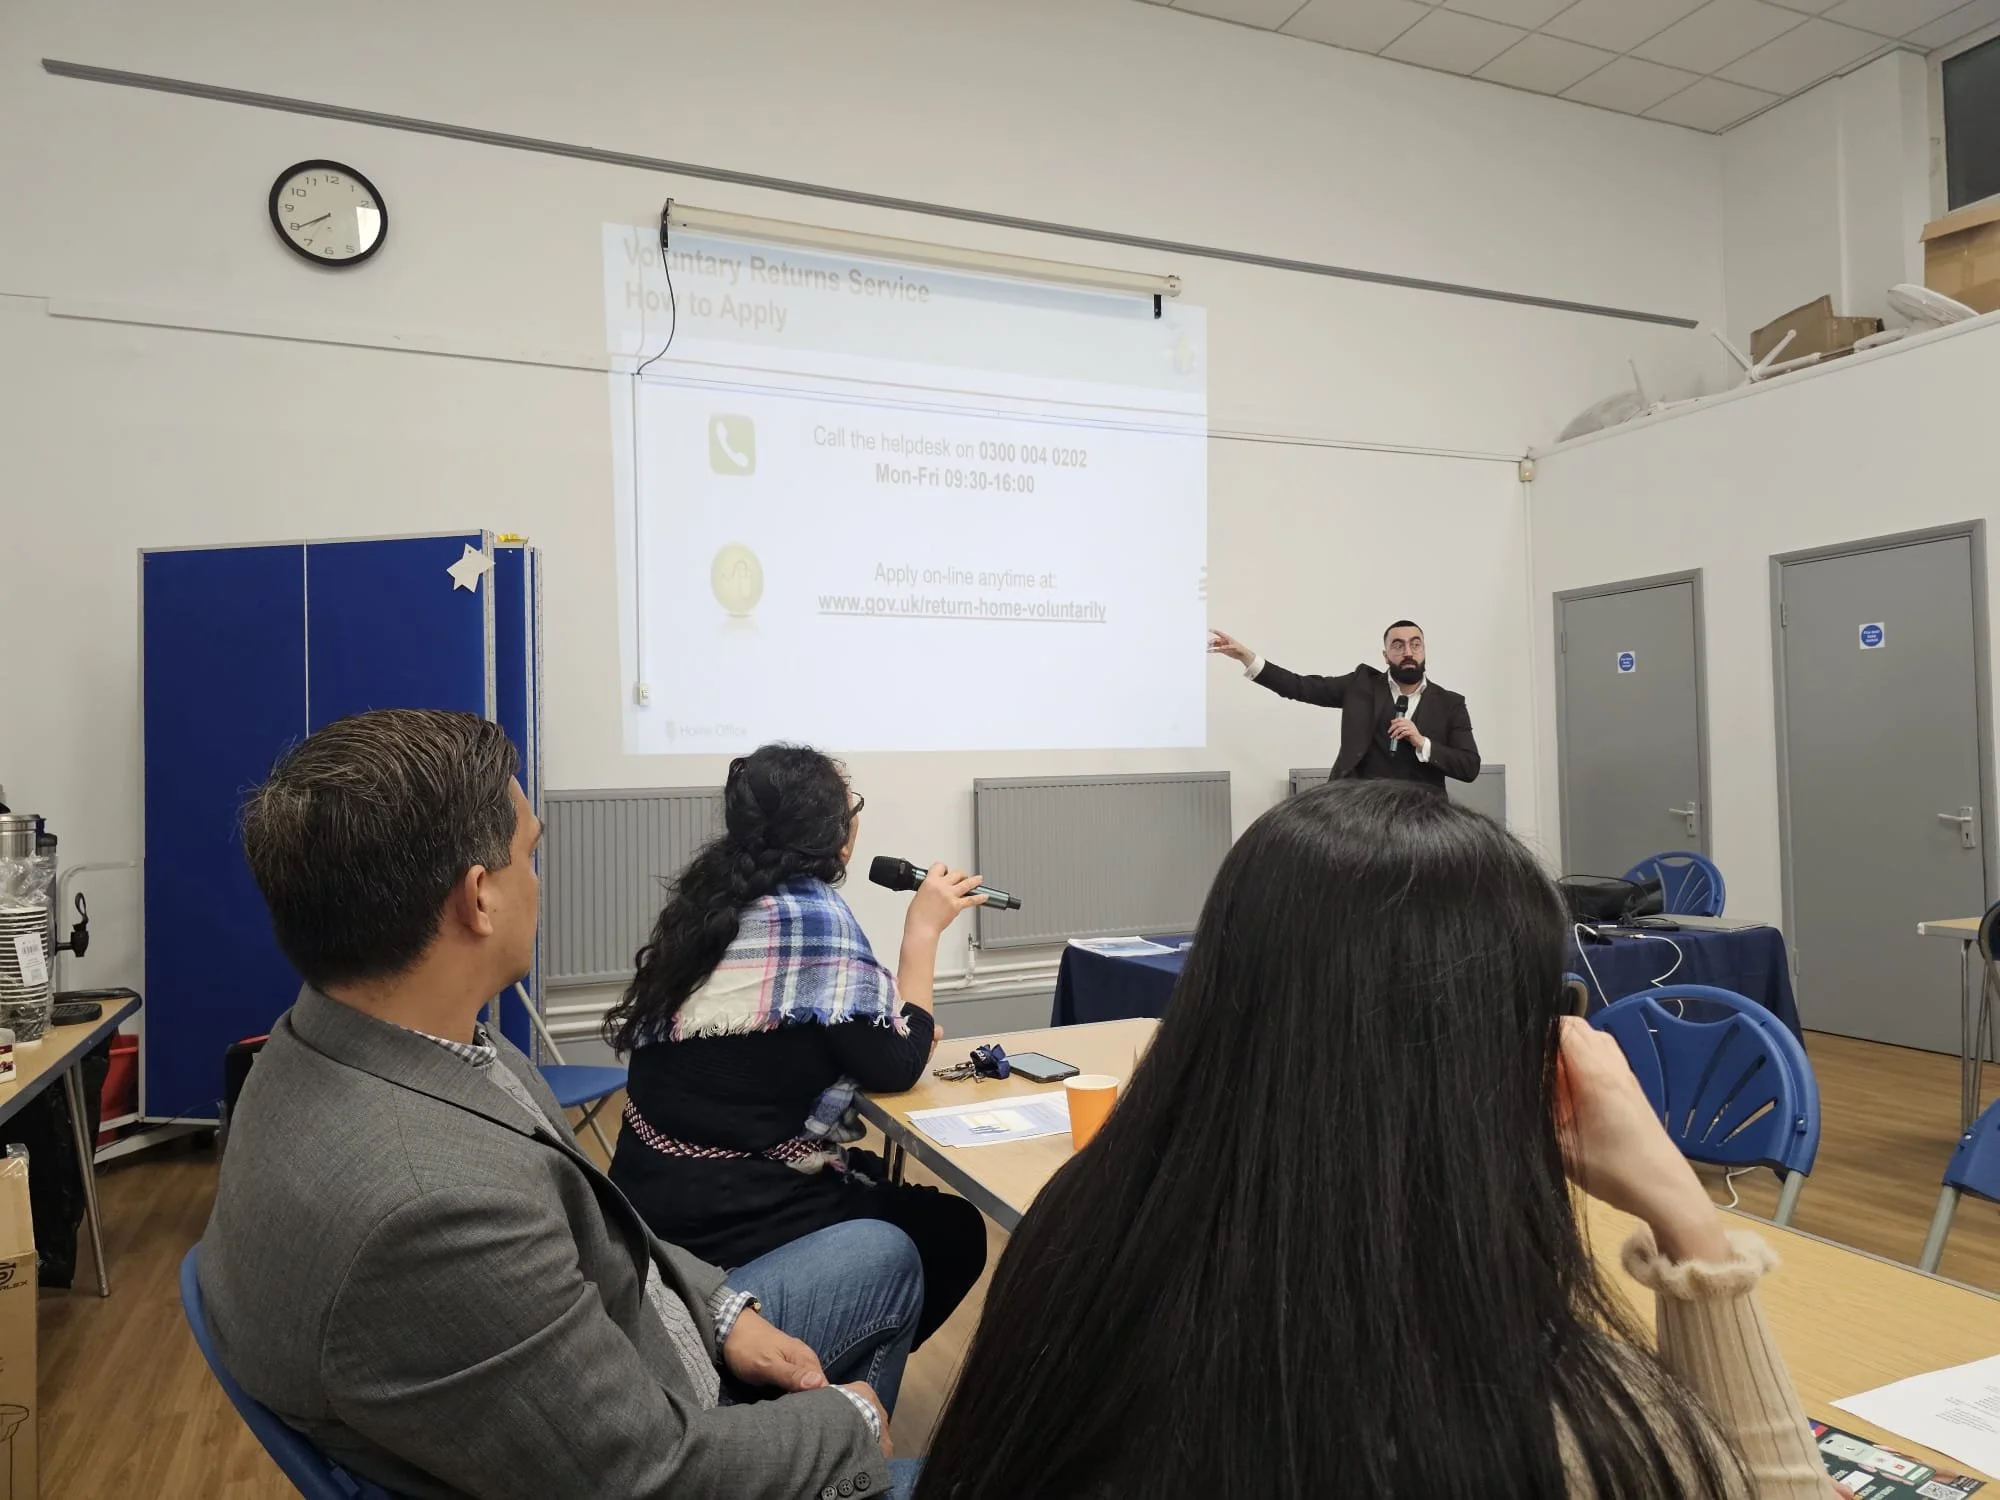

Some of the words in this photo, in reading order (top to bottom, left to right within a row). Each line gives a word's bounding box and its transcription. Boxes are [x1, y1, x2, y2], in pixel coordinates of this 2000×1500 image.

[305, 176, 317, 186] 11
[323, 174, 340, 185] 12
[291, 188, 307, 198] 10
[349, 184, 355, 193] 1
[284, 203, 295, 212] 9
[290, 222, 301, 231] 8
[303, 238, 313, 246] 7
[324, 246, 334, 255] 6
[345, 245, 355, 254] 5
[624, 237, 741, 285] Voluntary
[751, 254, 840, 292] Returns
[848, 268, 930, 302] Service
[626, 281, 680, 312] How
[690, 291, 712, 317] to
[719, 293, 787, 332] Apply
[814, 425, 845, 447] Call
[851, 430, 875, 450] the
[881, 432, 951, 457] helpdesk
[956, 443, 974, 458] on
[980, 441, 1015, 462] 0300
[1020, 445, 1047, 464] 004
[1052, 447, 1087, 468] 0202
[876, 463, 939, 486] Mon-Fri
[944, 468, 1034, 493] 09:30-16:00
[874, 562, 917, 586] Apply
[923, 566, 974, 585] on-line
[979, 568, 1035, 591] anytime
[1040, 570, 1057, 589] at:
[818, 594, 1106, 621] www.gov.uk/return-home-voluntarily
[680, 724, 712, 737] Home
